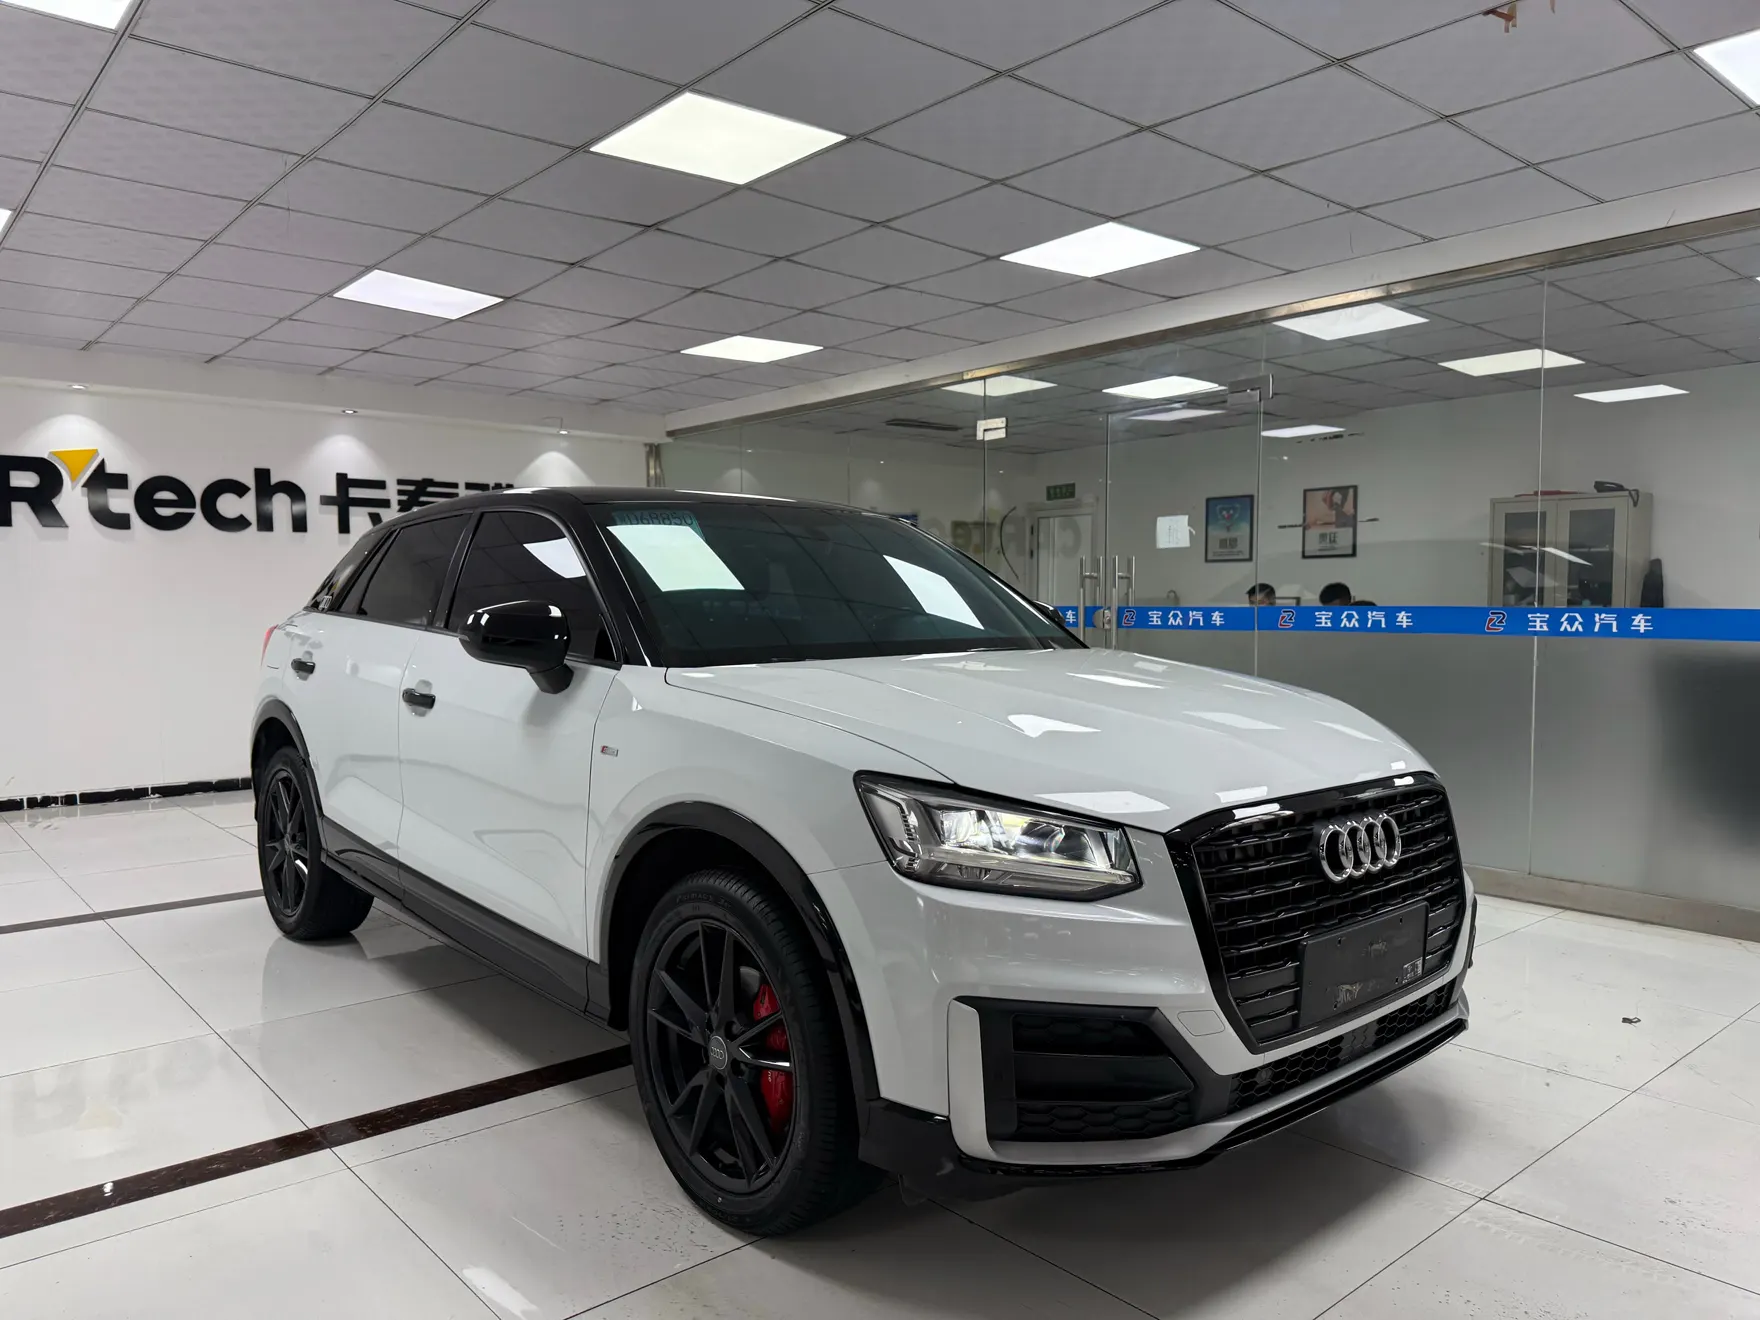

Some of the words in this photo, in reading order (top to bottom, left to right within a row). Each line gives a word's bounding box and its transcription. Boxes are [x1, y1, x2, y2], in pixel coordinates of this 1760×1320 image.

[1065, 609, 1077, 624] 车
[1148, 610, 1225, 627] 宝众汽车
[1314, 611, 1413, 629] 宝众汽车
[1527, 612, 1654, 634] 宝众汽车
